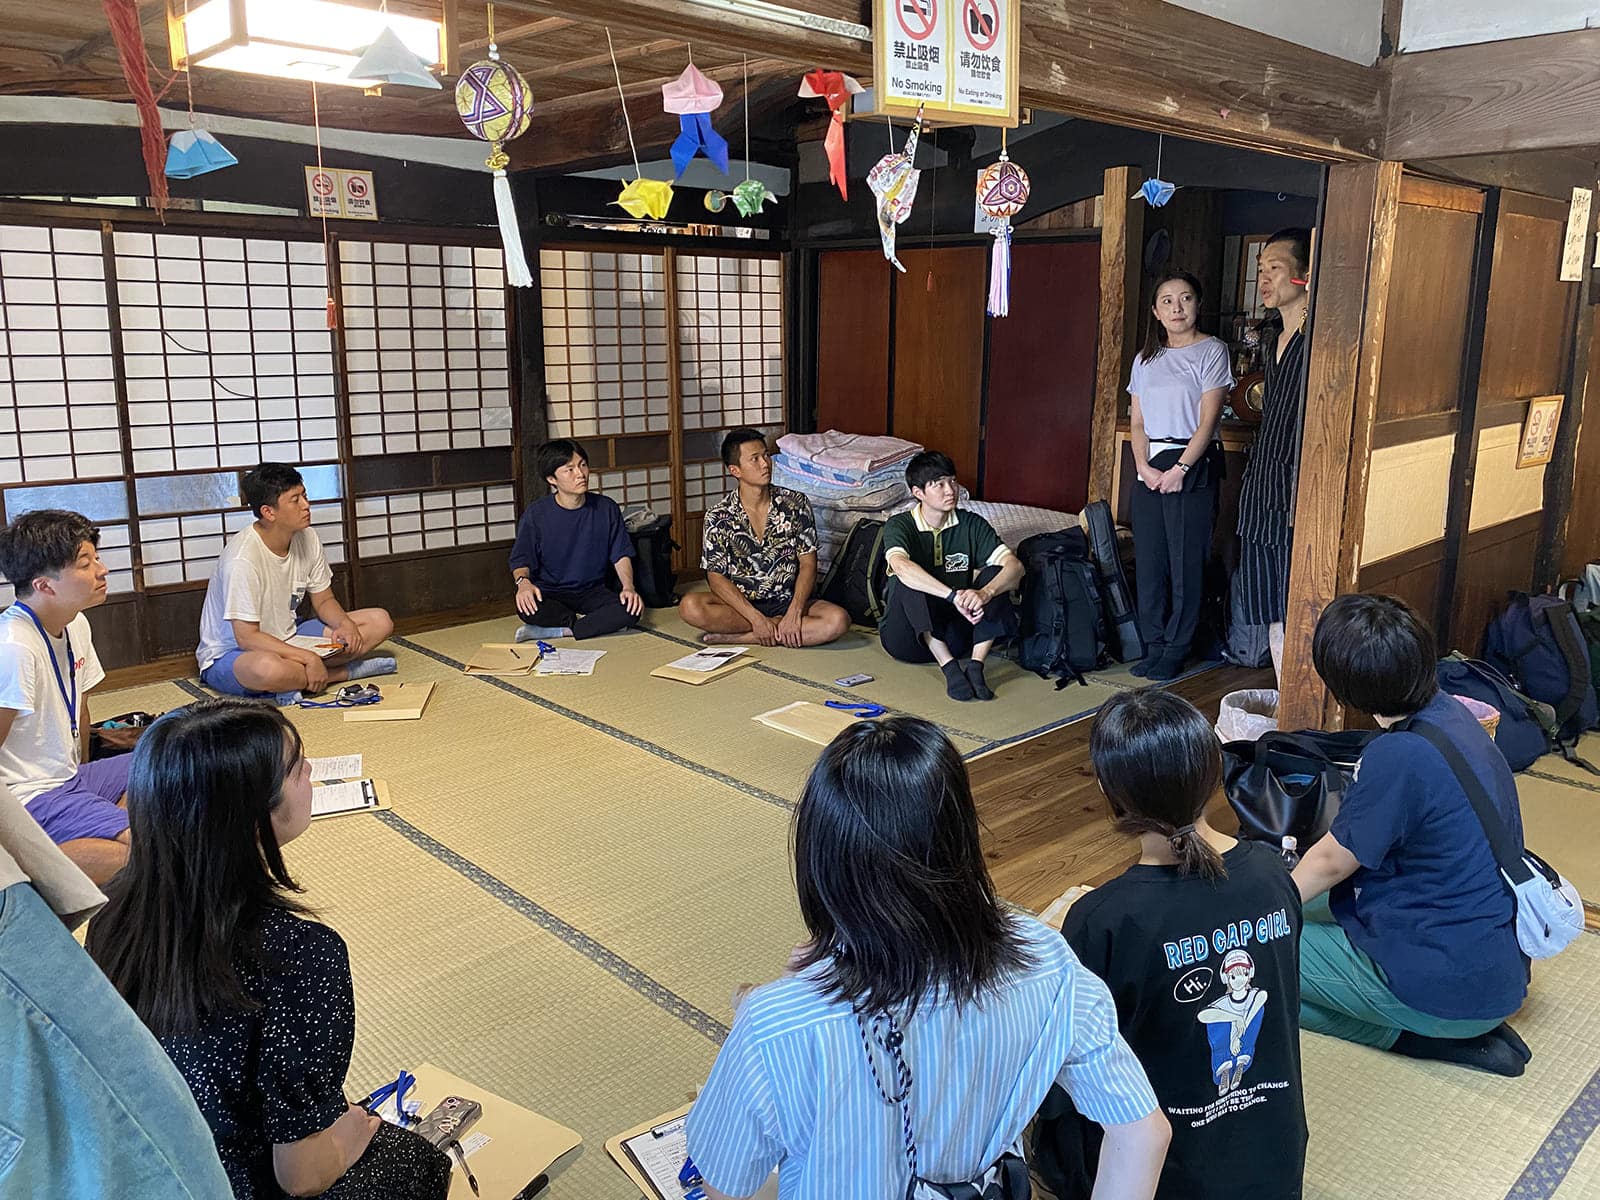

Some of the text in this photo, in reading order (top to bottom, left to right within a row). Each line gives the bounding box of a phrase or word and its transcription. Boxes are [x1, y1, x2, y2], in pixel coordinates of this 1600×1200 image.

[894, 40, 940, 64] 禁止吸烟
[960, 51, 1001, 73] 请勿饮食
[891, 77, 904, 89] No
[905, 78, 942, 95] Smoking
[958, 87, 965, 95] No
[965, 88, 979, 98] Eating
[985, 91, 1003, 101] Drinking
[1163, 908, 1291, 970] RED CAP GIRL
[1183, 976, 1207, 994] Hi.
[1168, 1106, 1204, 1115] WAITING
[1204, 1102, 1215, 1112] FOR
[1230, 1097, 1240, 1105] BE
[1190, 1119, 1206, 1128] ONE
[1229, 1104, 1239, 1112] TO
